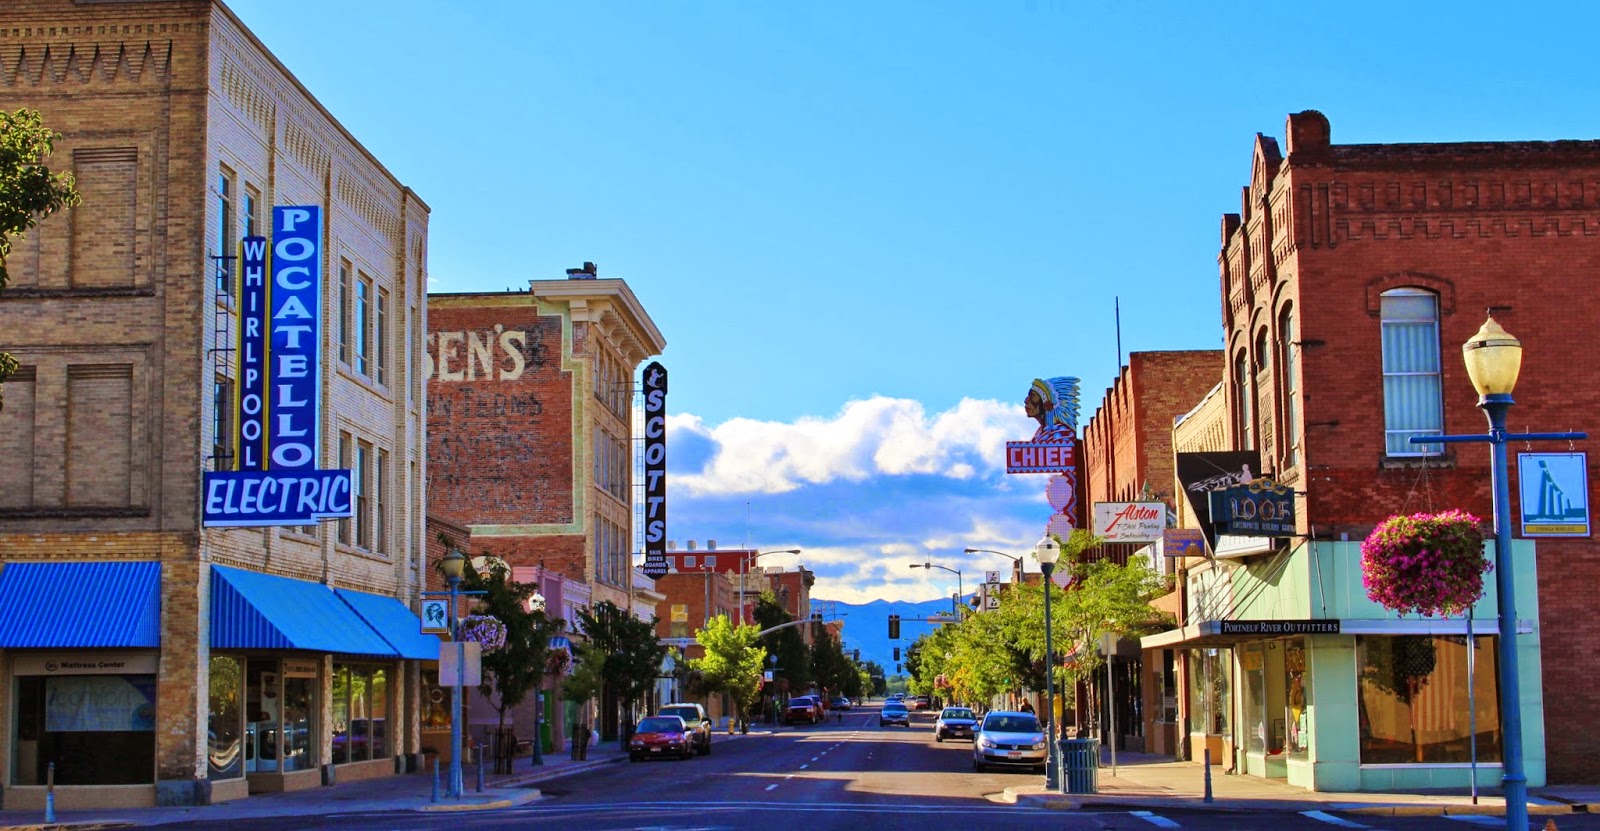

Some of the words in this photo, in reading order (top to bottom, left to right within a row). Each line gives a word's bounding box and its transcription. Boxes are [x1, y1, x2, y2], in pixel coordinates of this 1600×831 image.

[242, 241, 265, 466] WHIRLPOOL
[272, 209, 315, 467] POCATELLO
[645, 390, 665, 543] SCOTTS
[1010, 446, 1072, 467] CHIEF
[205, 475, 349, 514] ELECTRIC
[1105, 504, 1159, 532] Alston
[1260, 622, 1281, 632] RIVER
[1283, 622, 1338, 632] OUTFITTERS
